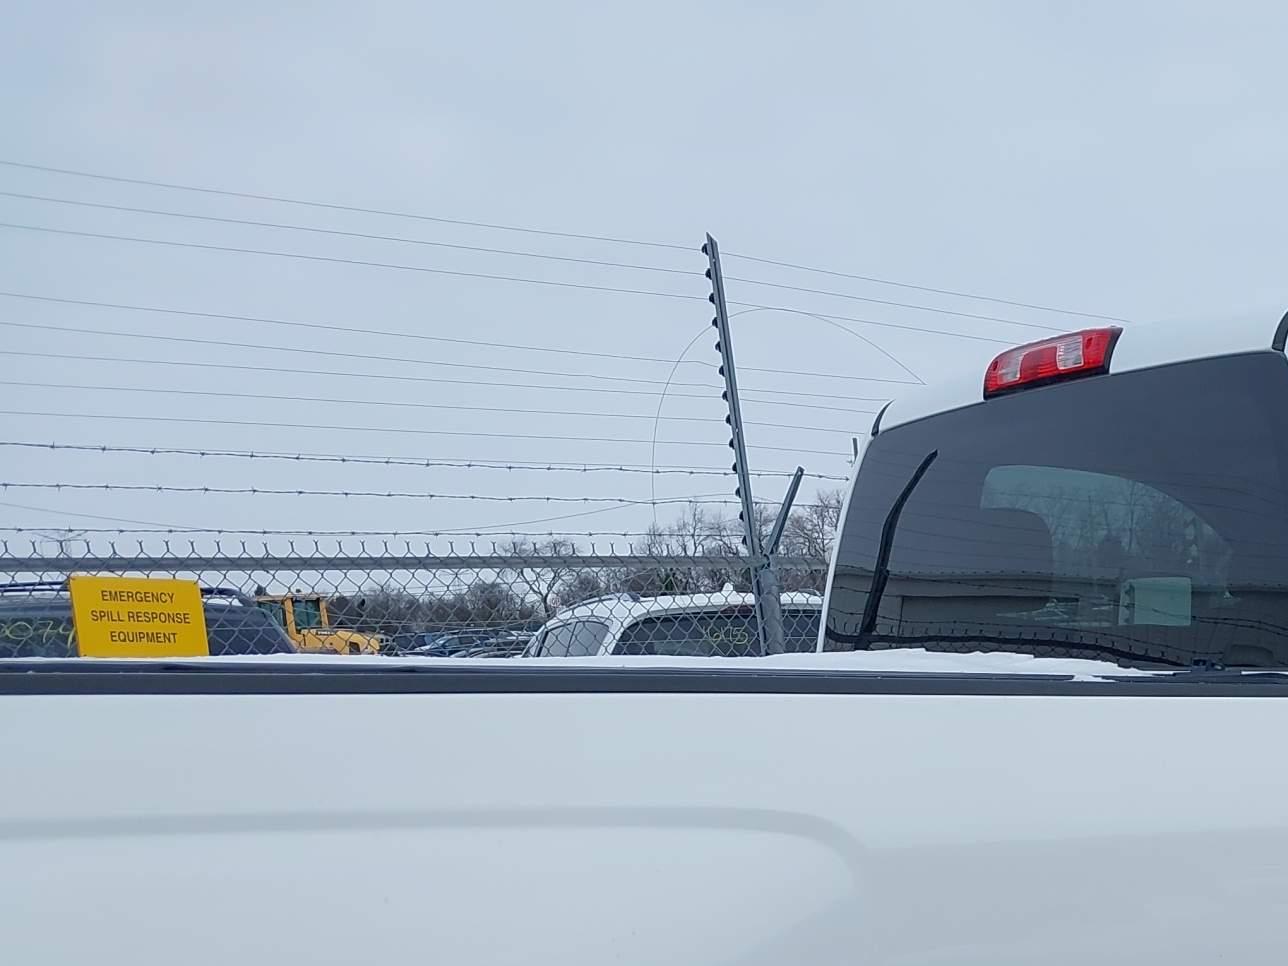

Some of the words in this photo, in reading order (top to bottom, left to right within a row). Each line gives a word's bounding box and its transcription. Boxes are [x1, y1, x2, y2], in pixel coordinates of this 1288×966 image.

[101, 590, 175, 603] EMERGENCY
[90, 610, 125, 623] SPILL
[128, 611, 191, 624] RESPONSE
[110, 631, 178, 644] EQUIPMENT
